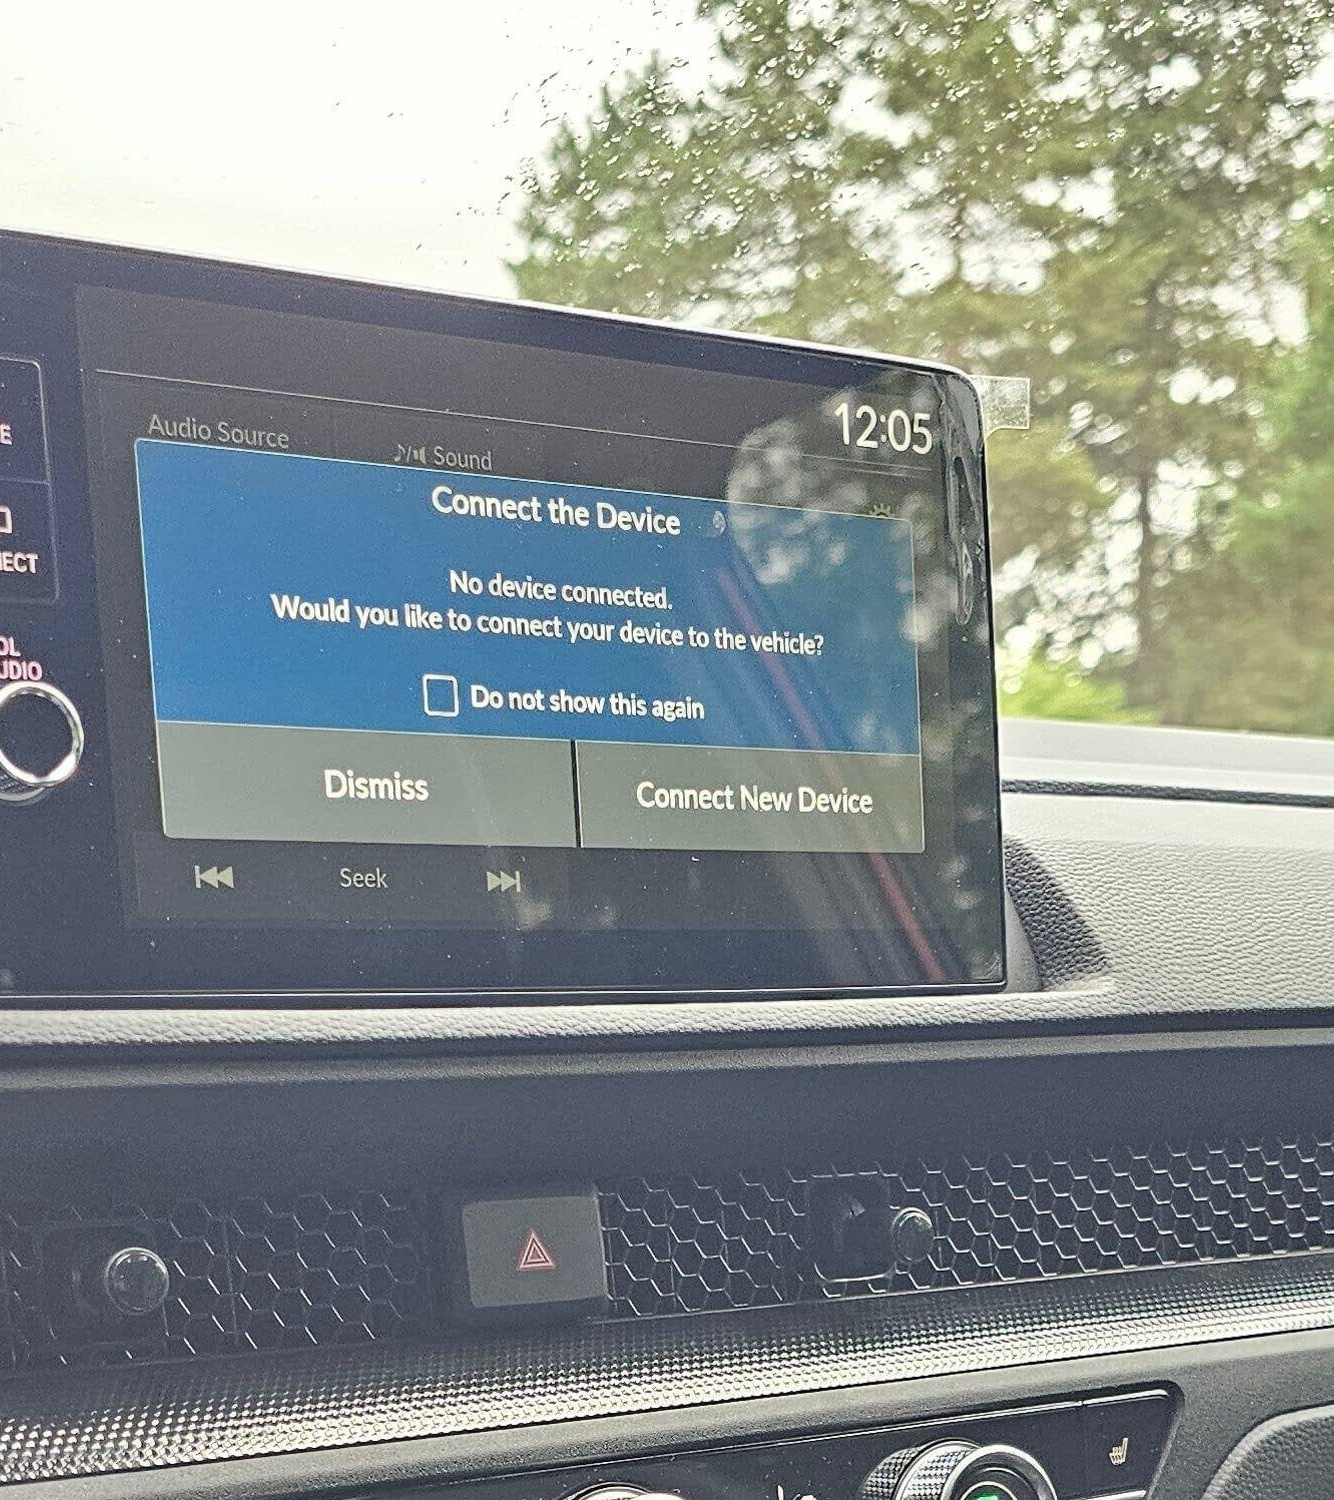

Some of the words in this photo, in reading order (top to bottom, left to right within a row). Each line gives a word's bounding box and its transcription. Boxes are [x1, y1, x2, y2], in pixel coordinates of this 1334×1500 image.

[148, 413, 211, 441] Audio
[217, 421, 290, 449] Source
[834, 401, 934, 455] 12:05
[434, 445, 493, 471] Sound
[431, 485, 543, 523] Connect
[547, 497, 590, 527] the
[596, 501, 681, 536] Device
[449, 569, 484, 595] No
[488, 573, 557, 601] device
[561, 584, 673, 610] connected.
[269, 593, 351, 623] Would
[355, 605, 399, 629] you
[404, 603, 443, 630] like
[447, 608, 472, 632] to
[477, 614, 563, 638] connect
[567, 620, 615, 644] your
[619, 620, 684, 646] device
[688, 626, 710, 648] to
[714, 627, 747, 650] the
[750, 630, 825, 656] vehicle?
[470, 684, 503, 709] Do
[508, 689, 545, 712] not
[549, 689, 605, 715] show
[609, 692, 648, 716] this
[651, 696, 705, 722] again
[324, 769, 430, 801] Dismiss
[636, 781, 735, 811] Connect
[740, 784, 793, 812] New
[798, 786, 873, 814] Device
[339, 866, 388, 889] Seek
